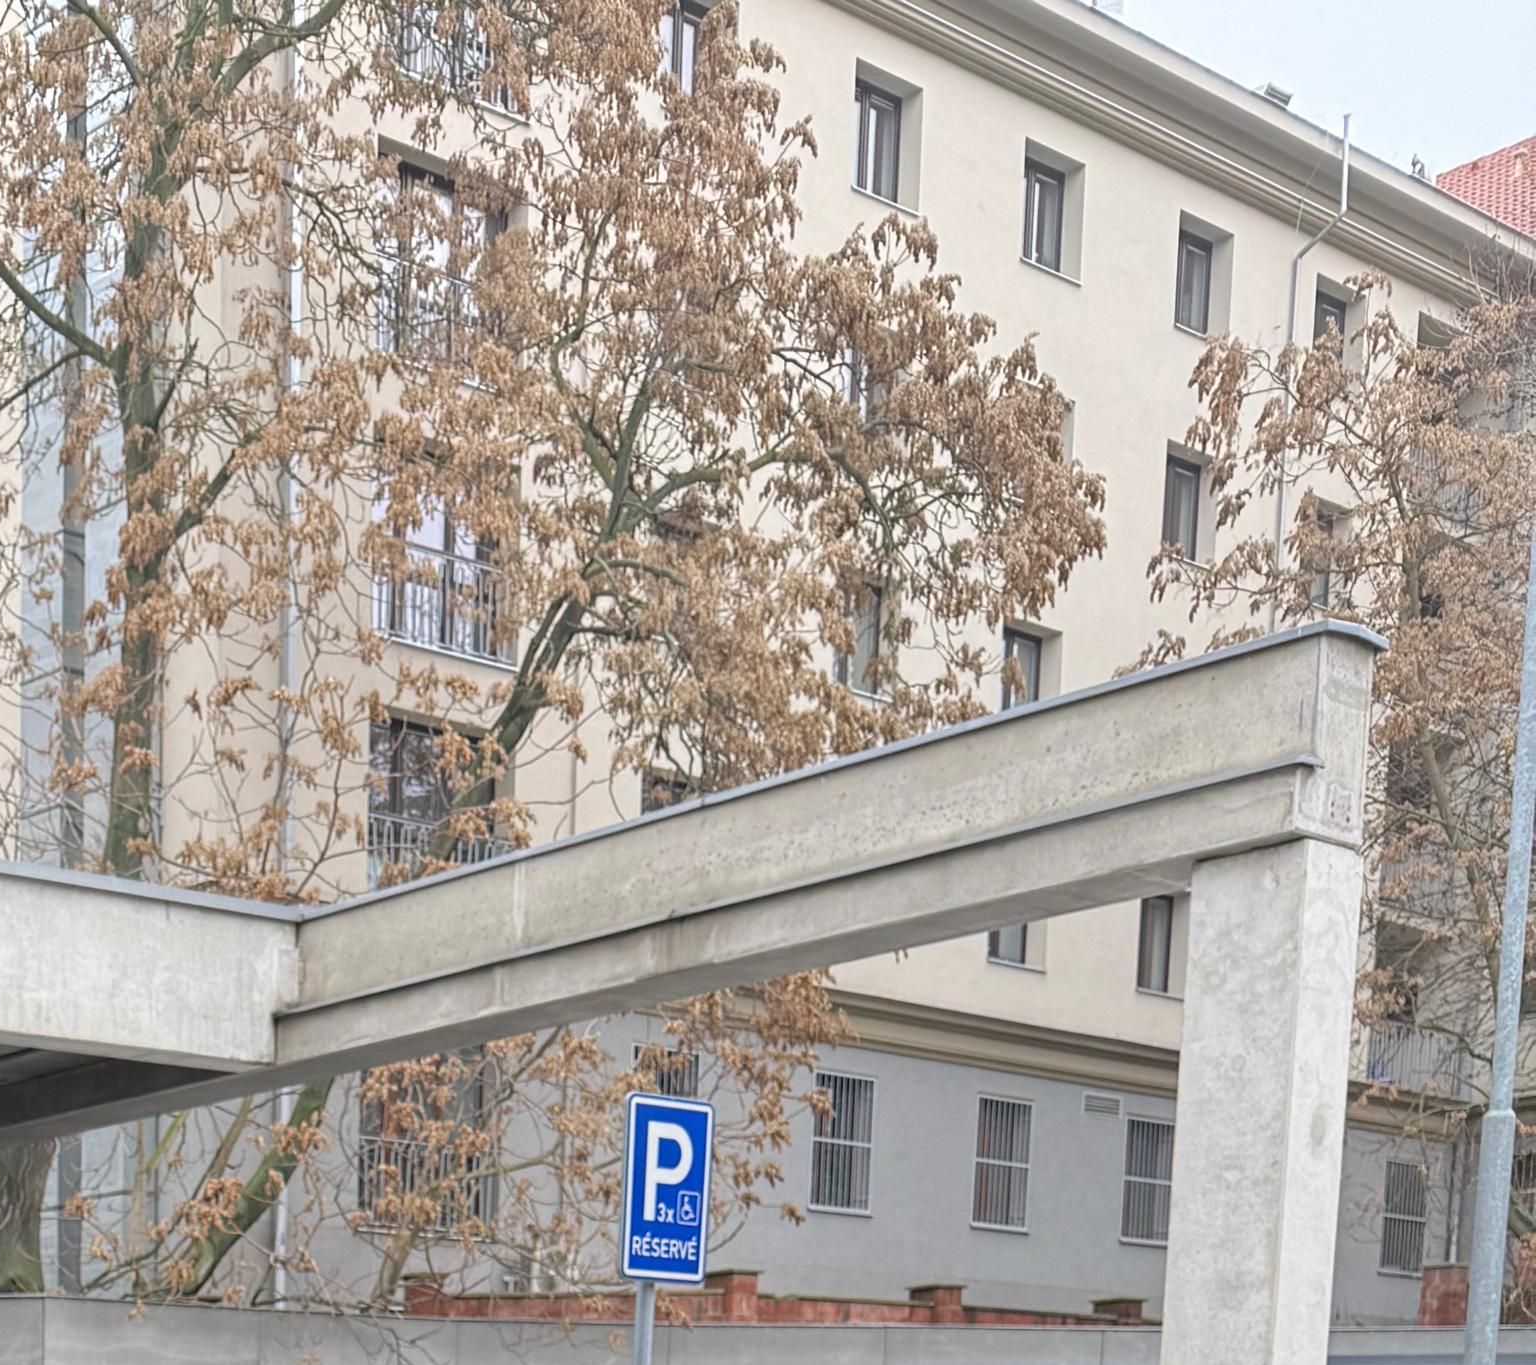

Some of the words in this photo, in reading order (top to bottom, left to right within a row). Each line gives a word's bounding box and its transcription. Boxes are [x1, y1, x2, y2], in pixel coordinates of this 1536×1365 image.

[642, 1120, 694, 1222] P
[657, 1202, 675, 1224] 3x
[631, 1231, 698, 1261] RÉSERVÉ
